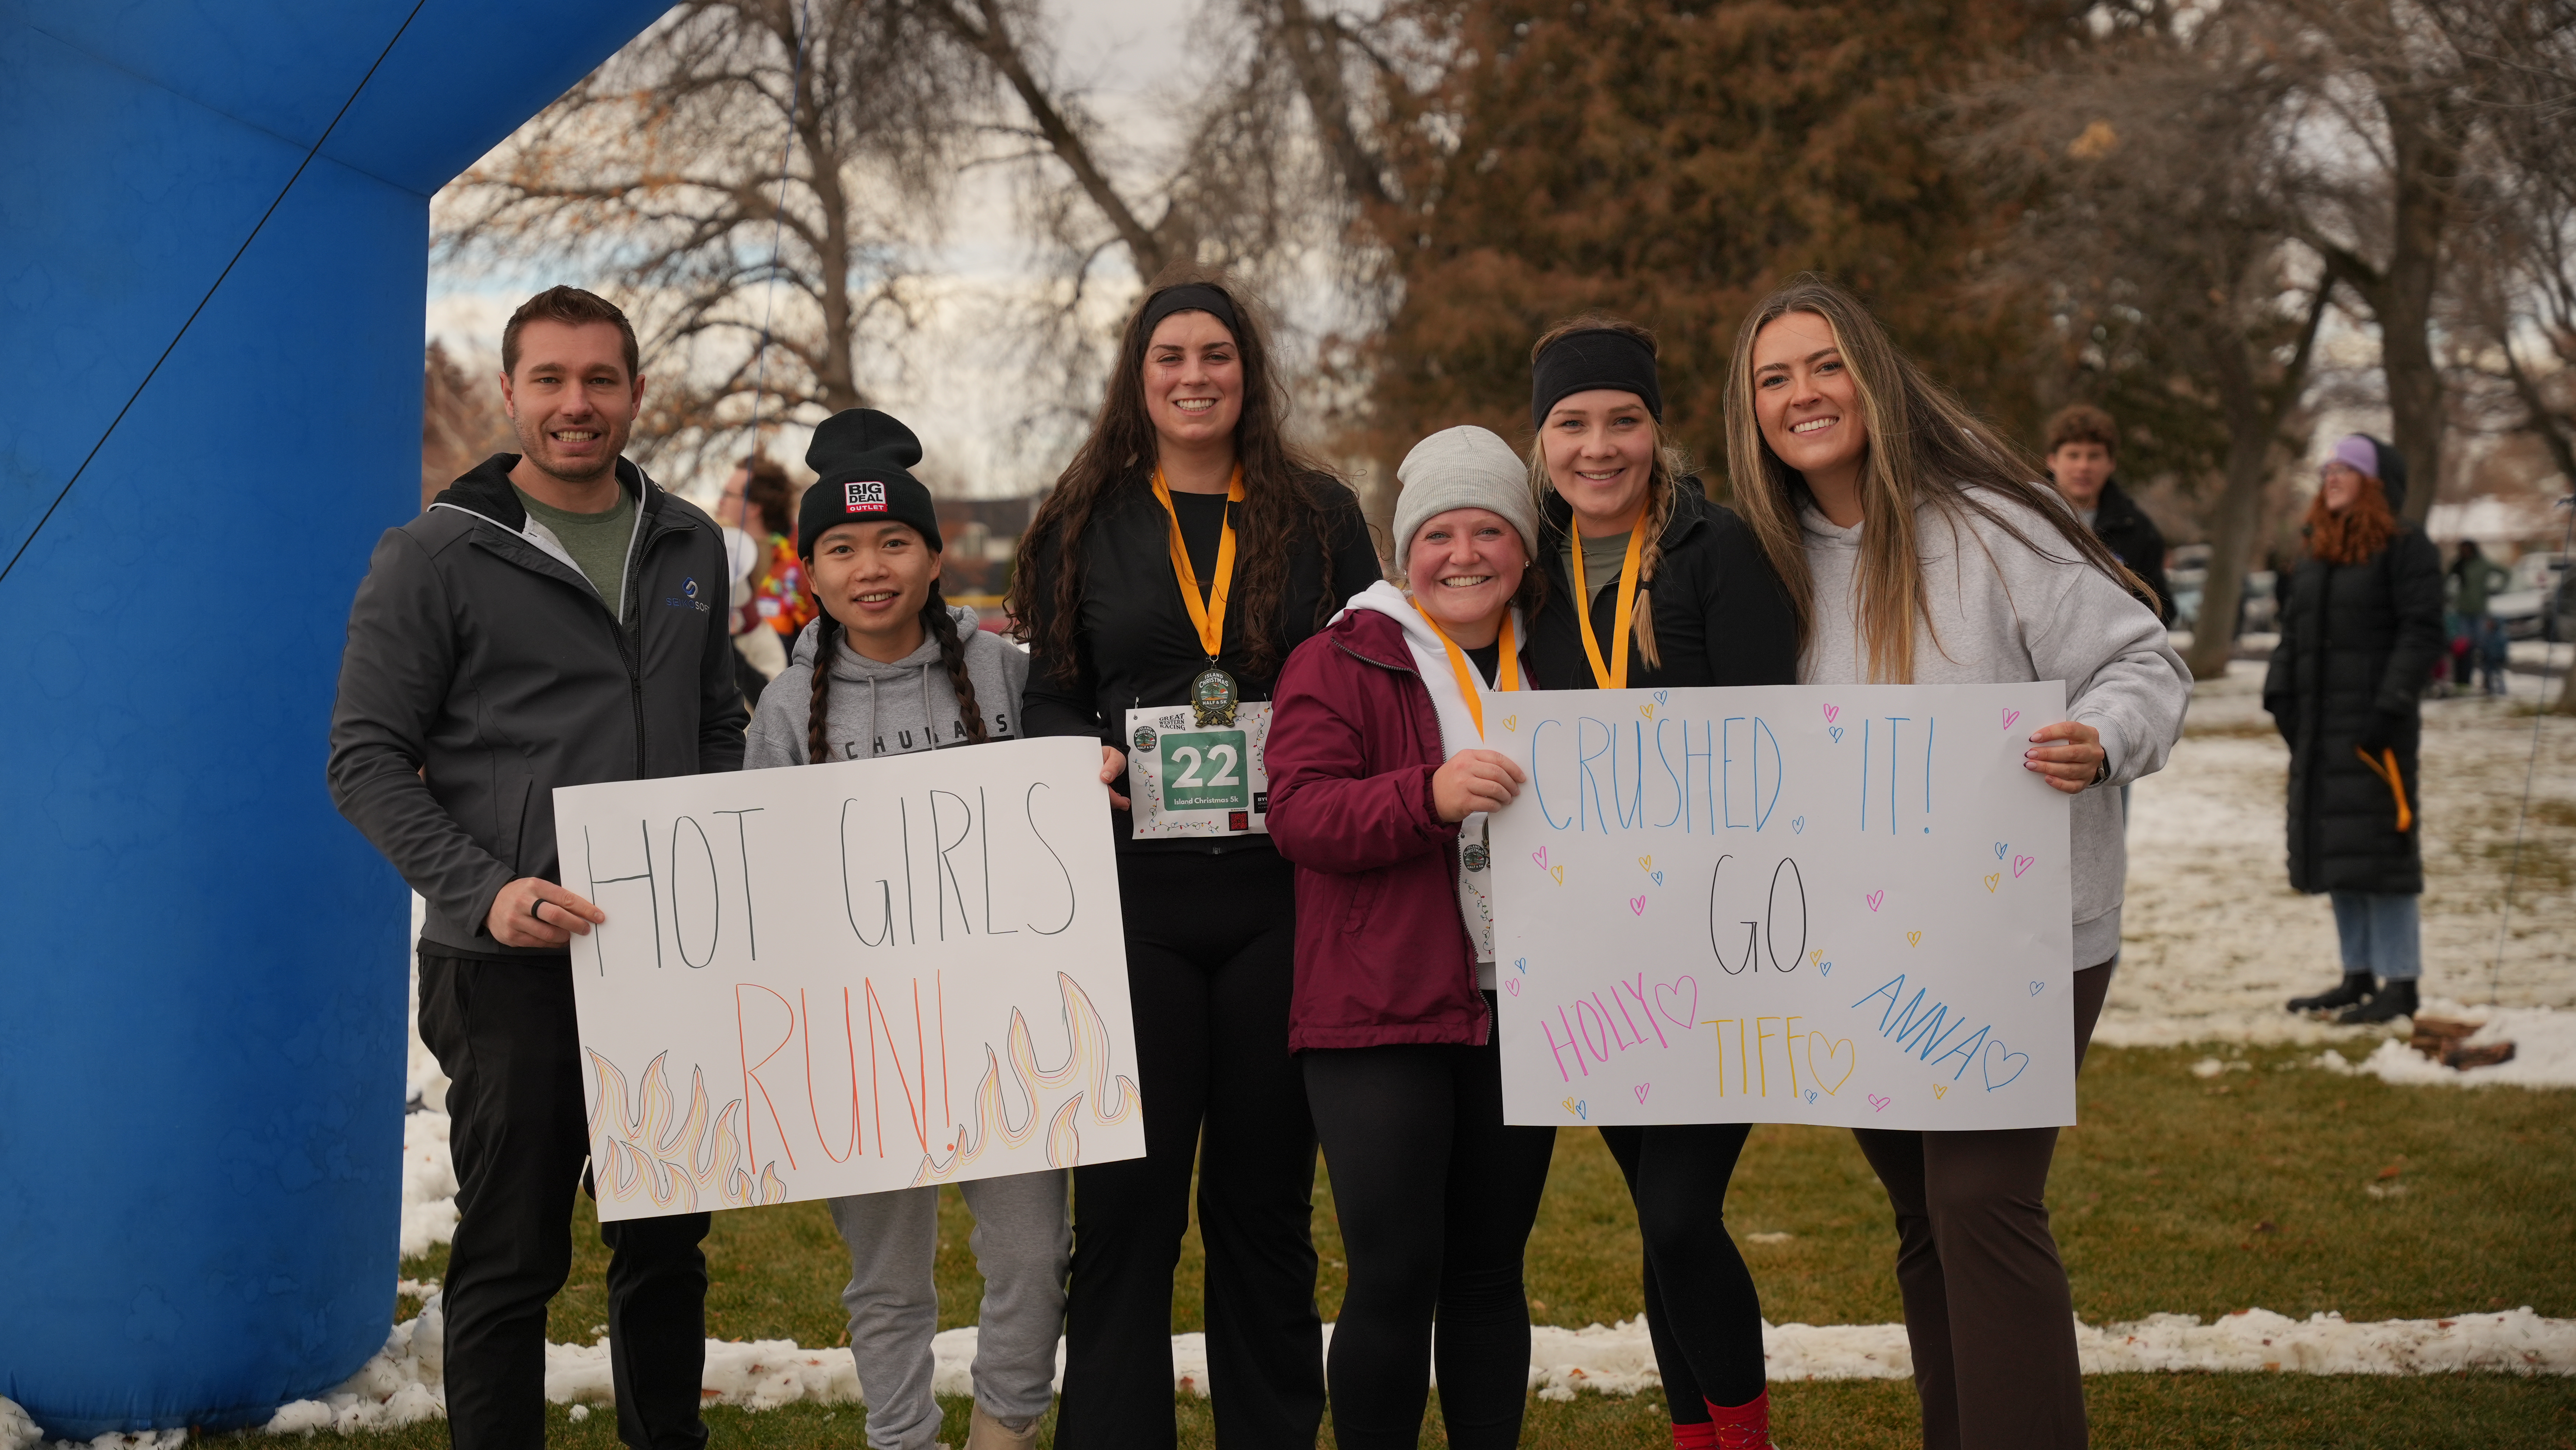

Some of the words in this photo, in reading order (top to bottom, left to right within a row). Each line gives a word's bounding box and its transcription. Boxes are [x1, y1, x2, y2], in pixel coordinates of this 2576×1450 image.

[848, 483, 882, 495] BIG
[849, 494, 883, 503] DEAL
[666, 598, 709, 615] SEIKOSOFT
[1199, 677, 1229, 688] CHRISTMAS
[845, 714, 1007, 760] CHUKAS
[1159, 712, 1185, 721] GREAT
[1171, 744, 1239, 788] 22
[1532, 717, 1782, 835] CRUSHED
[1862, 717, 1934, 835] IT!
[1464, 848, 1484, 857] CHRISTMAS
[585, 808, 765, 977] HOT
[841, 782, 1075, 947] GIRLS
[1710, 854, 1807, 975] GO
[1541, 972, 1668, 1082] HOLLY
[1851, 974, 1992, 1081] ANNA
[736, 969, 955, 1175] RUN!
[1701, 1016, 1805, 1098] TIFF
